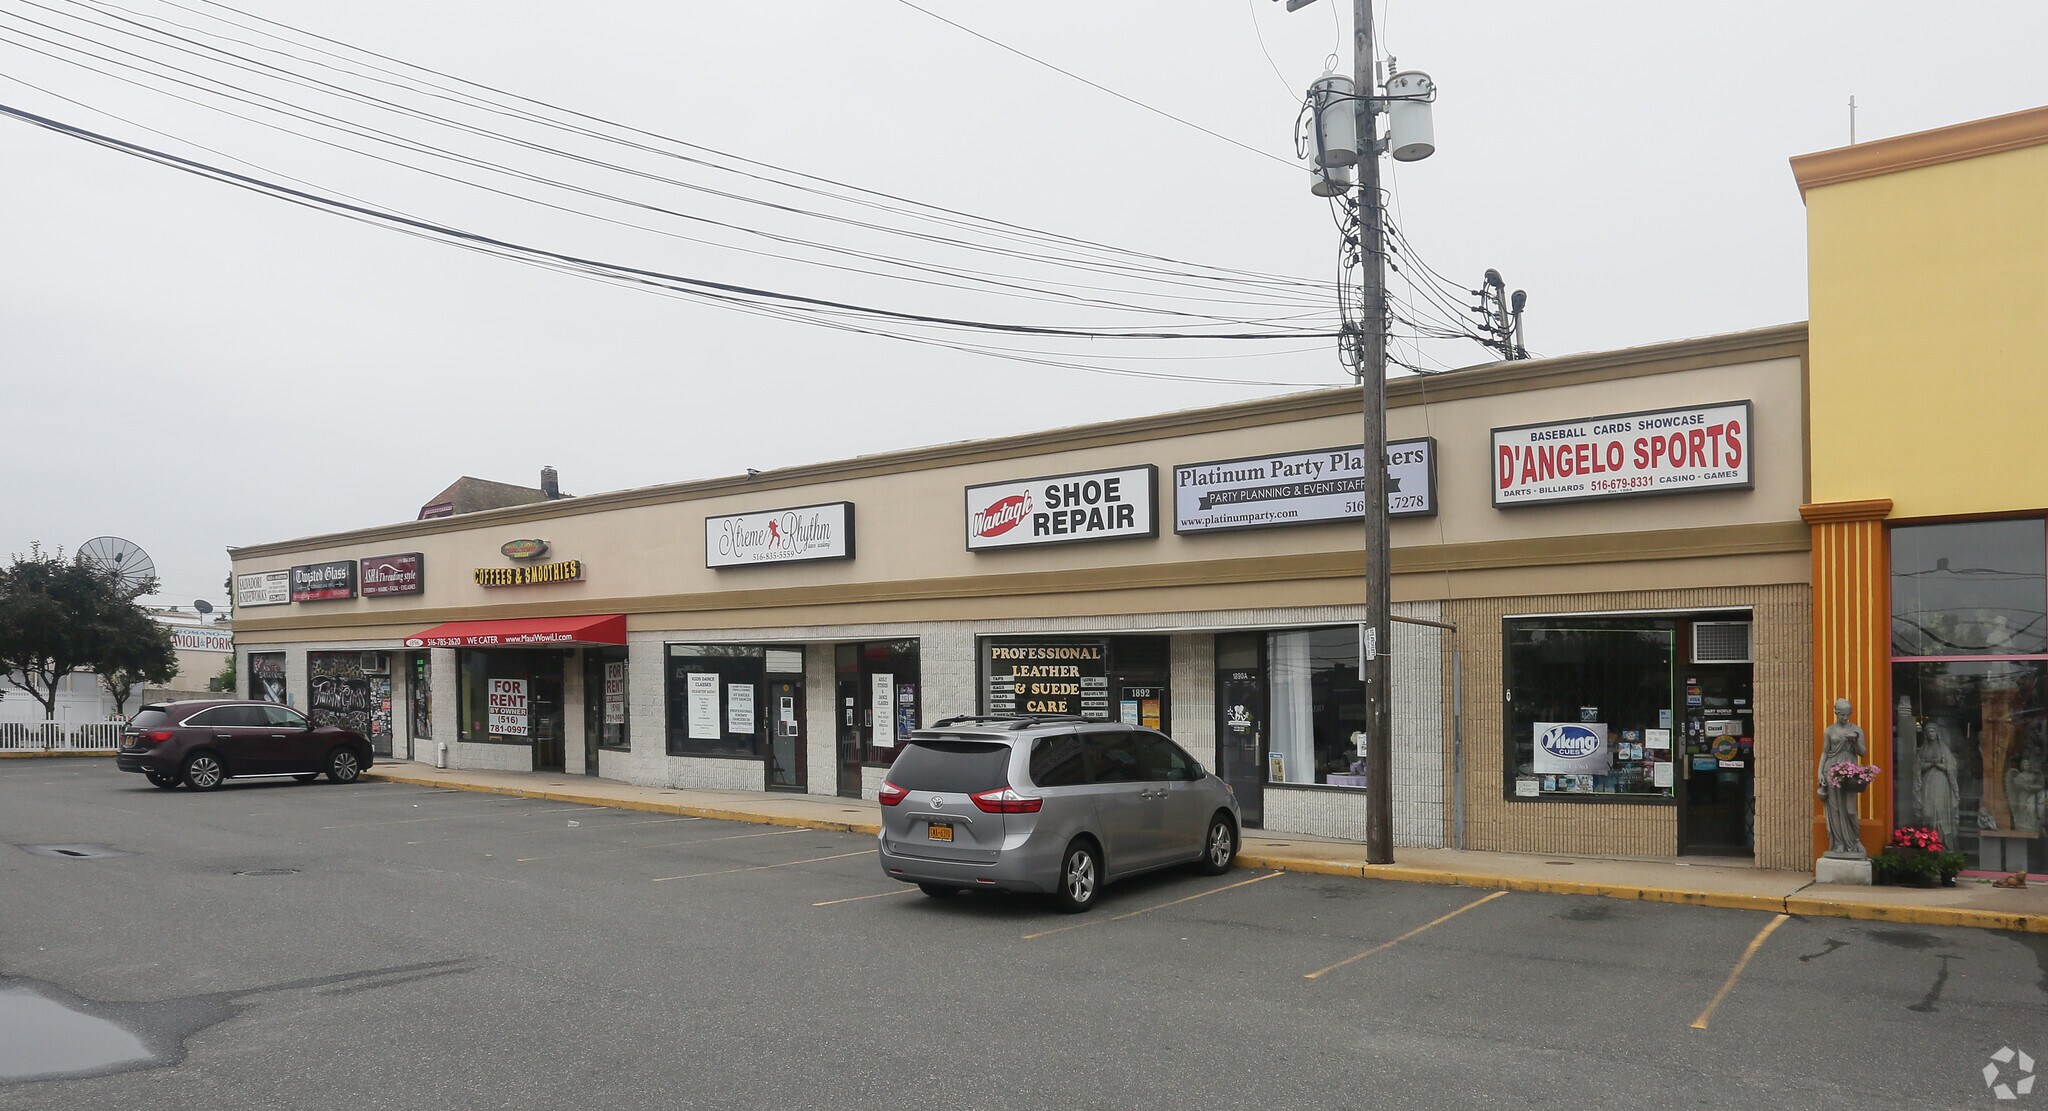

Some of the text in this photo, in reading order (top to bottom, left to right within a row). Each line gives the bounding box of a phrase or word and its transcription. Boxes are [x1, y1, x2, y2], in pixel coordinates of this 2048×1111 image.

[1530, 414, 1705, 442] BASEBALL CARDS SHOWCASE
[1499, 420, 1742, 490] D'ANGELO SPORTS
[1179, 448, 1425, 488] Platinum Party Plaers
[1503, 470, 1739, 497] DARTS BILLIARDS 516-679-8331 CASINO GAMES
[1045, 477, 1121, 509] SHOE
[1209, 491, 1238, 503] PARTY
[1240, 486, 1291, 501] PLANNING
[1293, 485, 1302, 496] &
[1303, 483, 1335, 495] EVENT
[973, 489, 1034, 538] Wantagh
[1033, 503, 1135, 536] REPAIR
[1181, 510, 1299, 527] www.platinumparty.com
[719, 511, 832, 558] Xtreme Rhythm
[752, 550, 795, 561] 516-835-5559
[324, 566, 347, 581] Glass
[474, 560, 577, 585] COFFEES & SMOOTHIES
[466, 637, 478, 645] WE
[478, 636, 499, 645] CATER
[991, 647, 1101, 660] PROFESSIONAL
[608, 665, 621, 678] FOR
[1011, 665, 1080, 678] LEATHER
[494, 680, 521, 693] FOR
[606, 680, 623, 694] RENT
[1014, 683, 1080, 695] & SUEDE
[1131, 688, 1151, 698] 1892
[490, 694, 526, 707] RENT
[1026, 700, 1068, 713] CARE
[500, 708, 526, 716] OWNER
[497, 716, 519, 725] (516)
[490, 725, 527, 734] 781-0997
[1543, 727, 1595, 754] Viking
